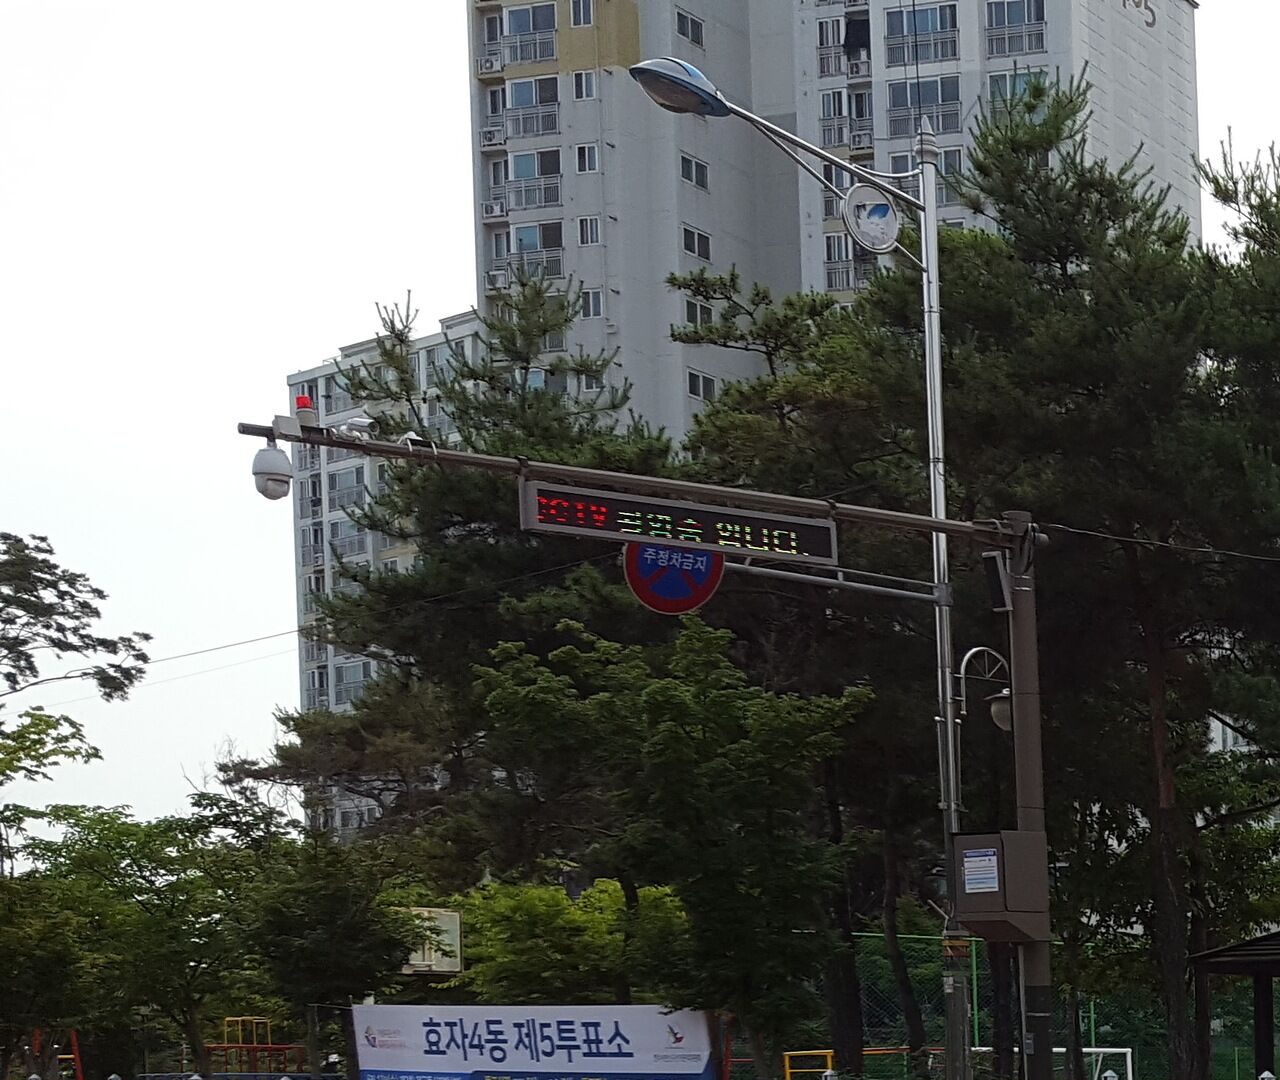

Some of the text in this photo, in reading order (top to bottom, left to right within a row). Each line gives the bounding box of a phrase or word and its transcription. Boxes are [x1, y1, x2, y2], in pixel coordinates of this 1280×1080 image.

[643, 547, 707, 572] 주정차금지
[423, 1017, 509, 1063] 효자4동
[511, 1017, 634, 1064] 제5투표소
